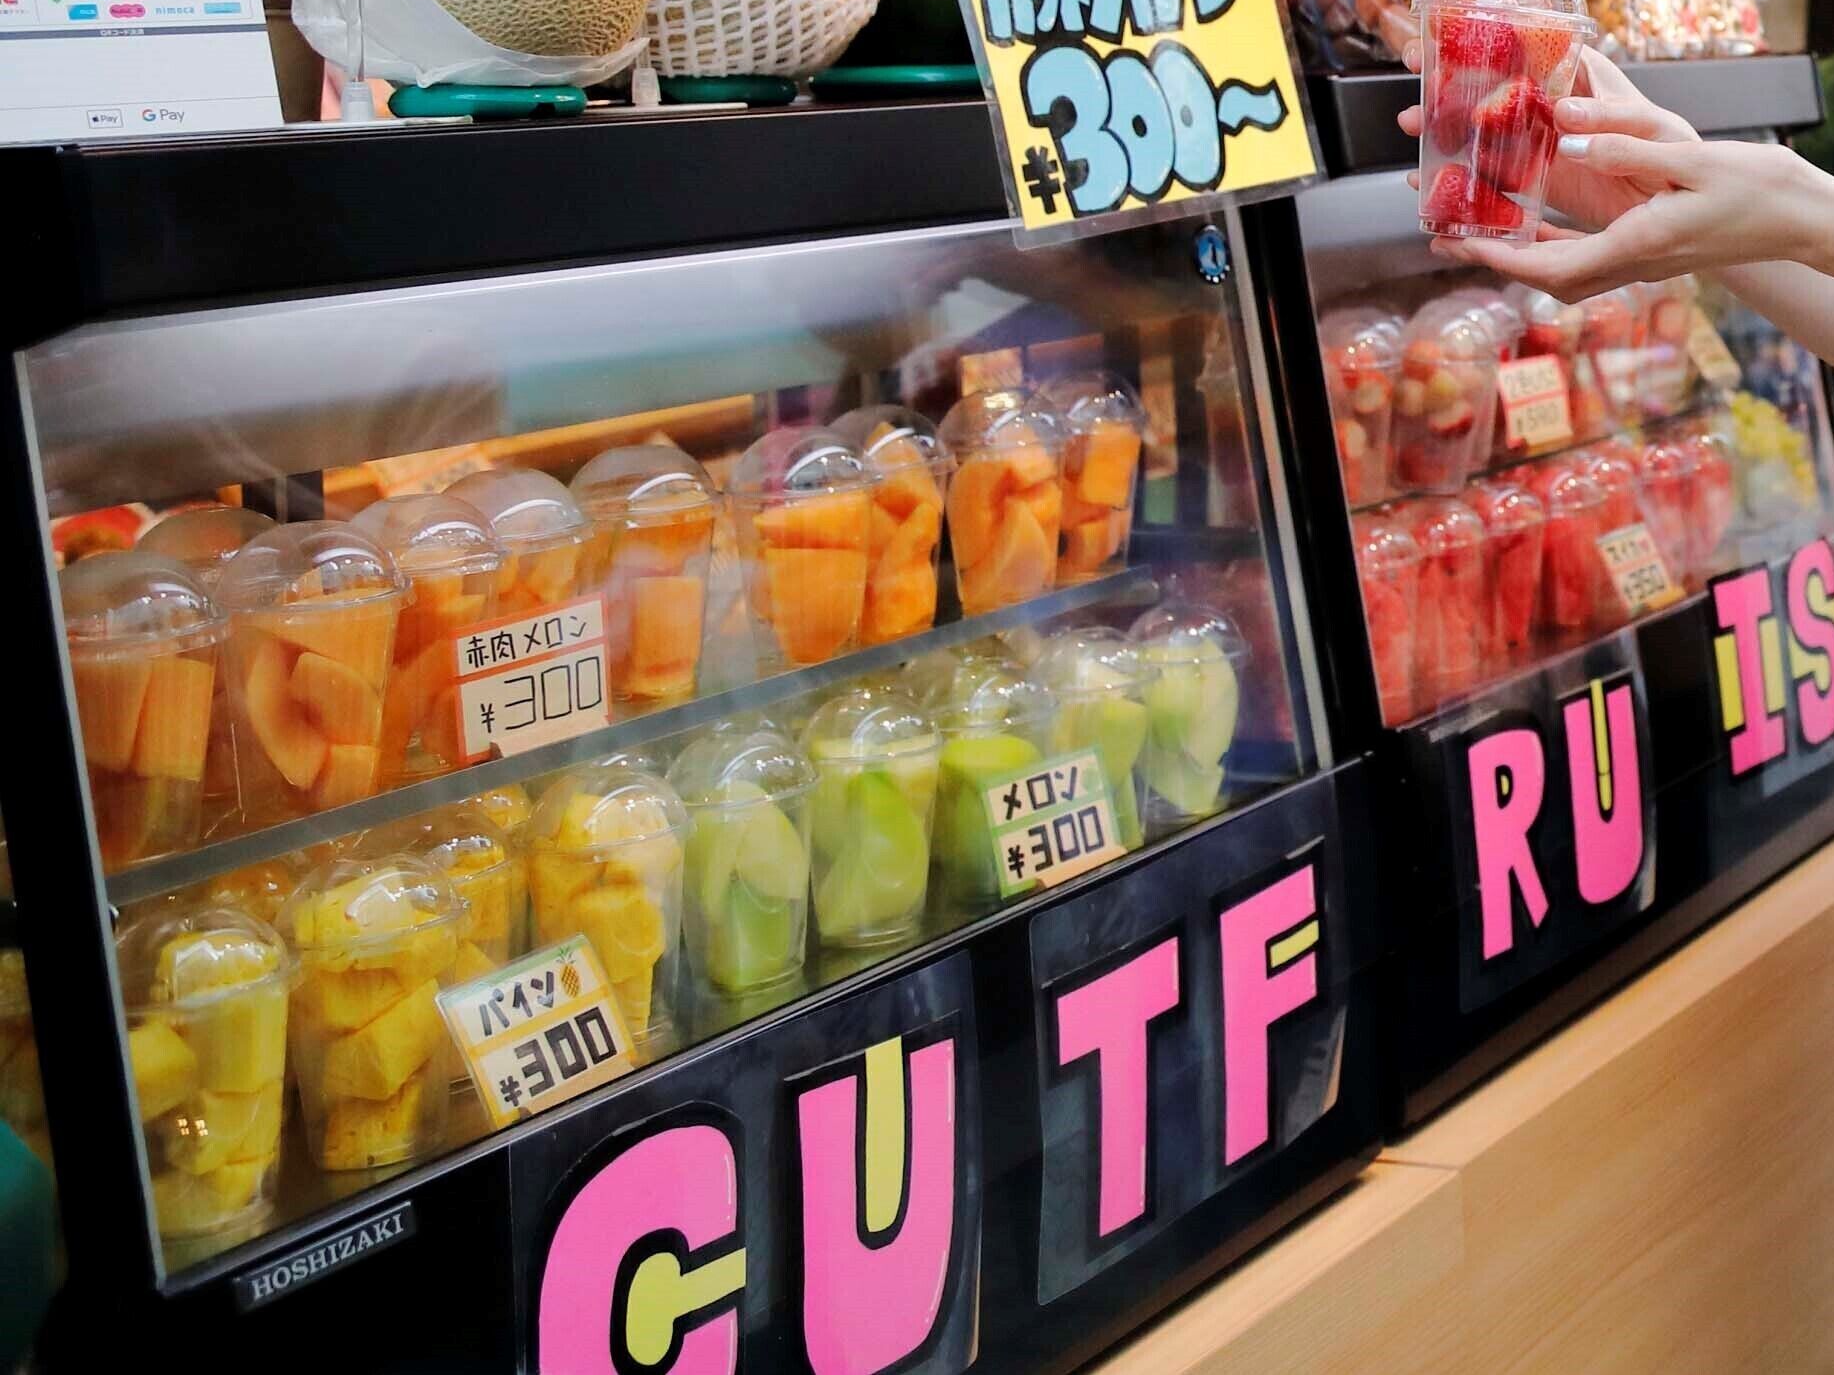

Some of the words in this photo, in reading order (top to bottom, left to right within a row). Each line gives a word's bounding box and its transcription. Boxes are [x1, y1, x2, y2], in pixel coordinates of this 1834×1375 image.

[156, 6, 195, 14] nimoca
[160, 109, 185, 121] Pay
[467, 616, 586, 668] 赤肉メロン
[481, 656, 602, 733] ¥300
[1003, 766, 1077, 820] メロン
[1008, 806, 1104, 879] ¥300
[479, 971, 554, 1036] パイン
[499, 1007, 617, 1107] ¥300
[252, 1213, 404, 1300] HOSHIZAKI
